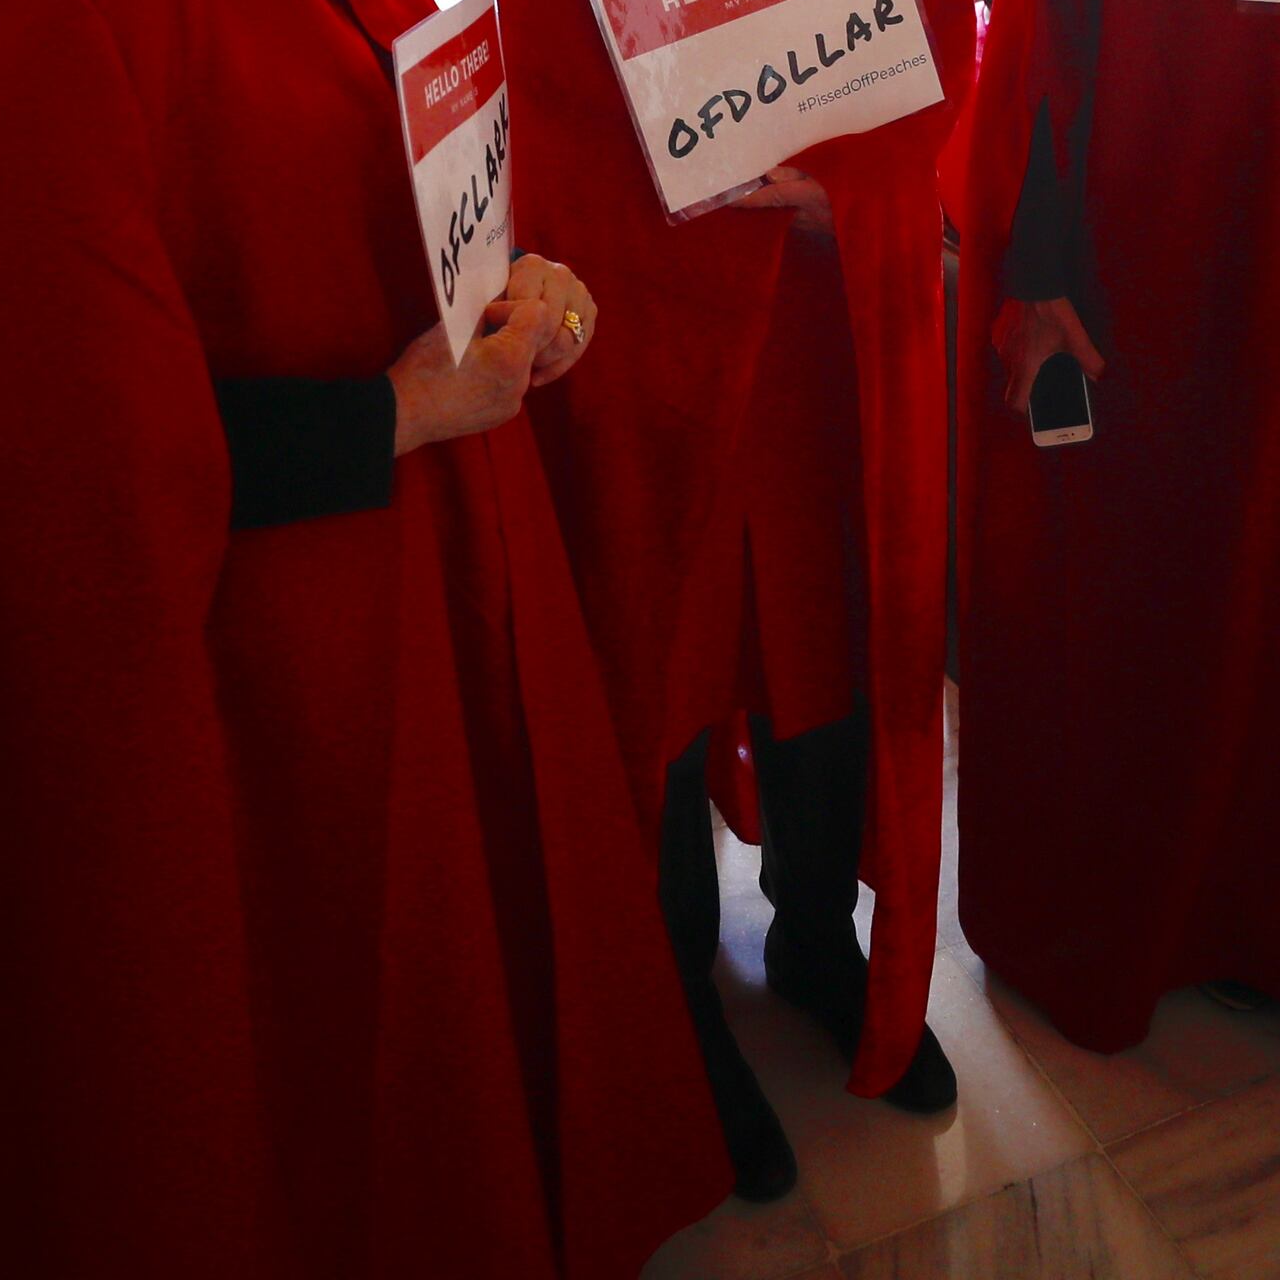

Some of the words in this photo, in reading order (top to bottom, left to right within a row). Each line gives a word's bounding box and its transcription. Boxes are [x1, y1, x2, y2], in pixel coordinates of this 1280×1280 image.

[424, 65, 460, 109] HELLO
[460, 39, 491, 80] THERE!
[796, 53, 927, 114] #PissedOffPeaches
[440, 93, 510, 307] OFCLARK
